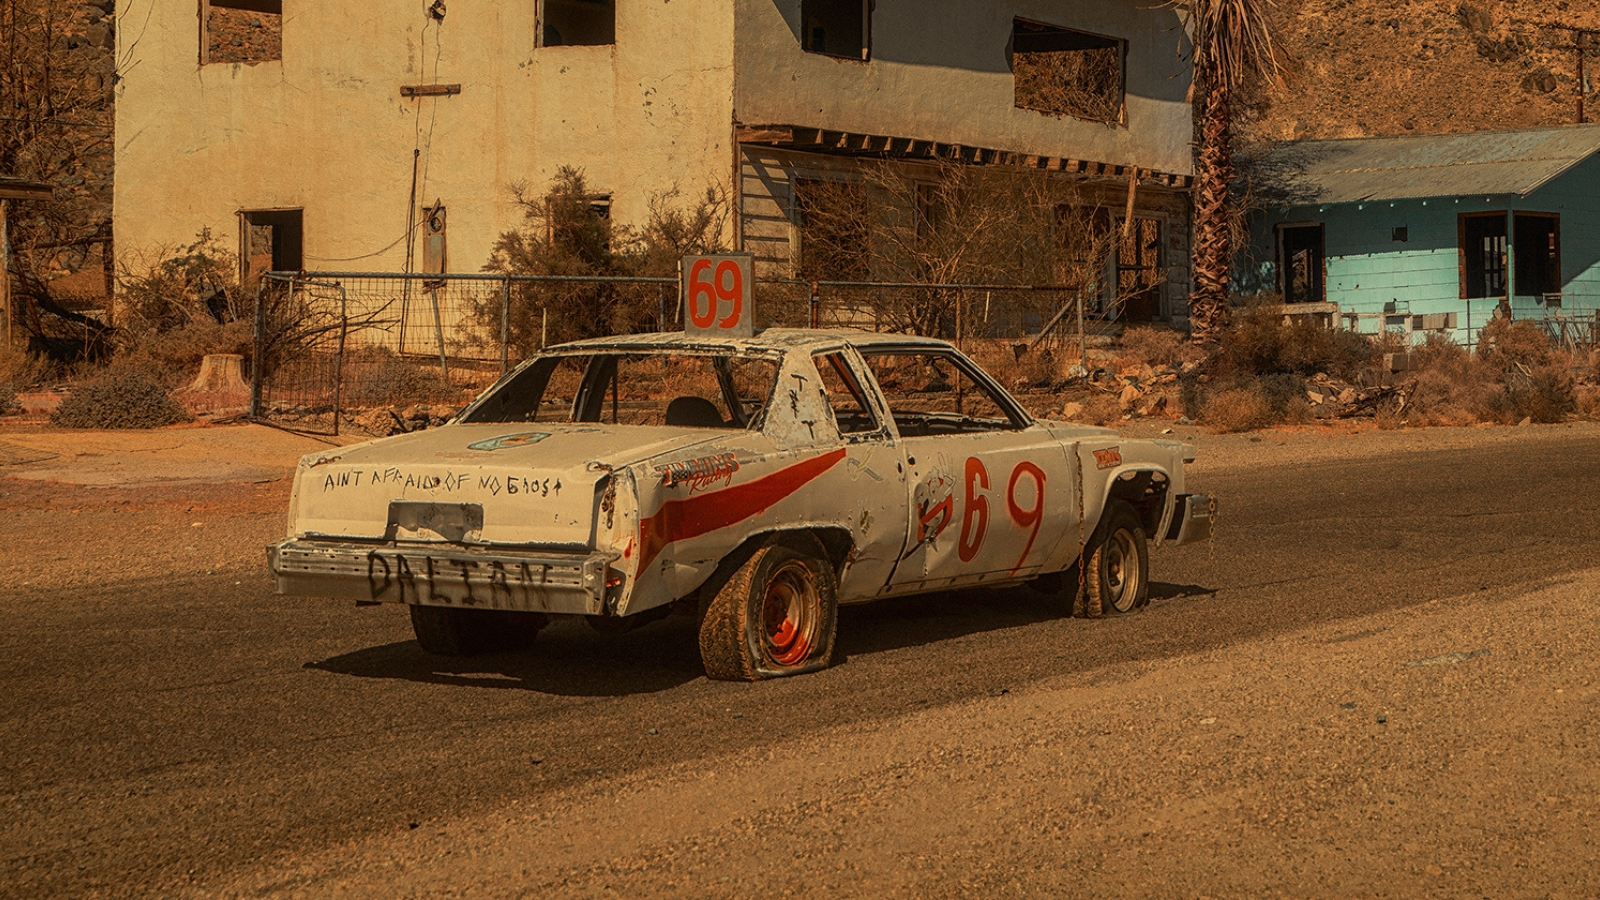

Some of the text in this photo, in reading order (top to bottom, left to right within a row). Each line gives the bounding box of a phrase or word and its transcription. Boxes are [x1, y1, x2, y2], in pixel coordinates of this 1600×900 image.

[688, 258, 743, 329] 69
[444, 472, 470, 492] OF
[478, 474, 502, 496] NO
[685, 466, 732, 495] Racing
[957, 456, 1047, 578] 69
